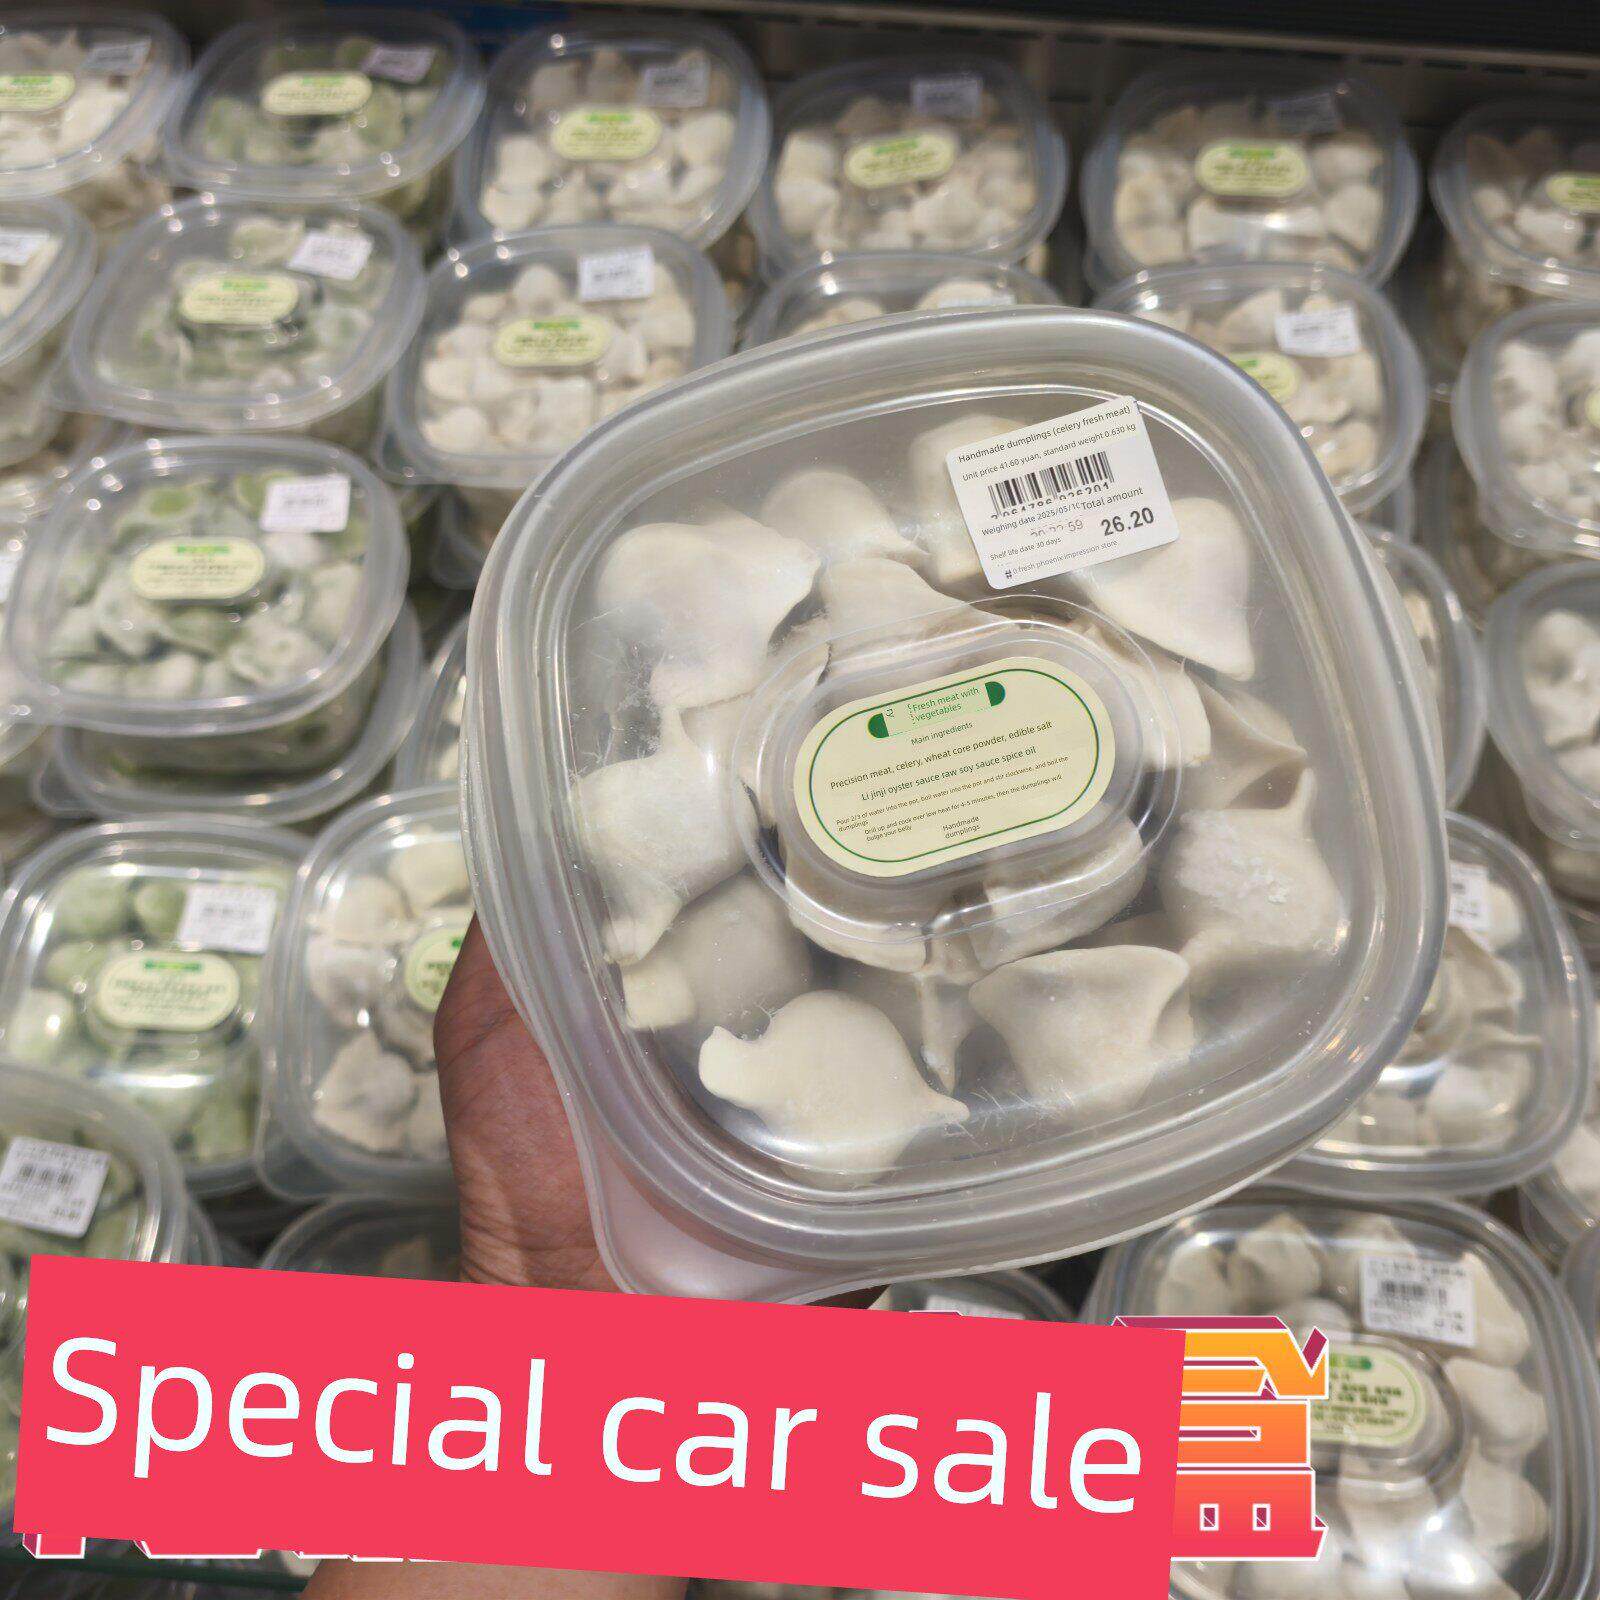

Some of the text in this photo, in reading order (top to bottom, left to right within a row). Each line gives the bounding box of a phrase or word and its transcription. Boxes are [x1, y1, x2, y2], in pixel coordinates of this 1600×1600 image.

[958, 404, 1131, 463] Handmade dumplings (celery fresh meat)
[962, 471, 980, 482] Unit
[979, 465, 999, 478] price
[999, 458, 1020, 471] 41.60
[1019, 453, 1042, 466] yuan,
[1042, 440, 1077, 457] standard
[1077, 431, 1104, 447] weight
[1125, 423, 1137, 432] kg
[1080, 486, 1144, 510] Total amount
[981, 521, 1018, 536] Weighing
[1018, 516, 1036, 526] date
[1100, 507, 1155, 537] 26.20
[989, 550, 1007, 561] Shelf
[1019, 544, 1035, 553] date
[1035, 540, 1045, 549] 30
[1045, 536, 1062, 546] days
[912, 686, 980, 712] Fresh meat with
[914, 703, 962, 722] vegetables
[910, 722, 973, 746] Main ingredients
[830, 773, 869, 790] Precision
[923, 750, 952, 763] wheat
[952, 744, 972, 755] core
[1008, 726, 1036, 740] edible
[1036, 721, 1053, 732] salt
[887, 781, 913, 794] oyster
[915, 774, 940, 787] sauce
[941, 769, 957, 779] raw
[958, 764, 974, 774] soy
[975, 757, 1000, 770] sauce
[1001, 750, 1024, 764] spice
[1024, 745, 1037, 756] oil
[942, 816, 980, 832] Handmade
[944, 824, 981, 840] dumplings
